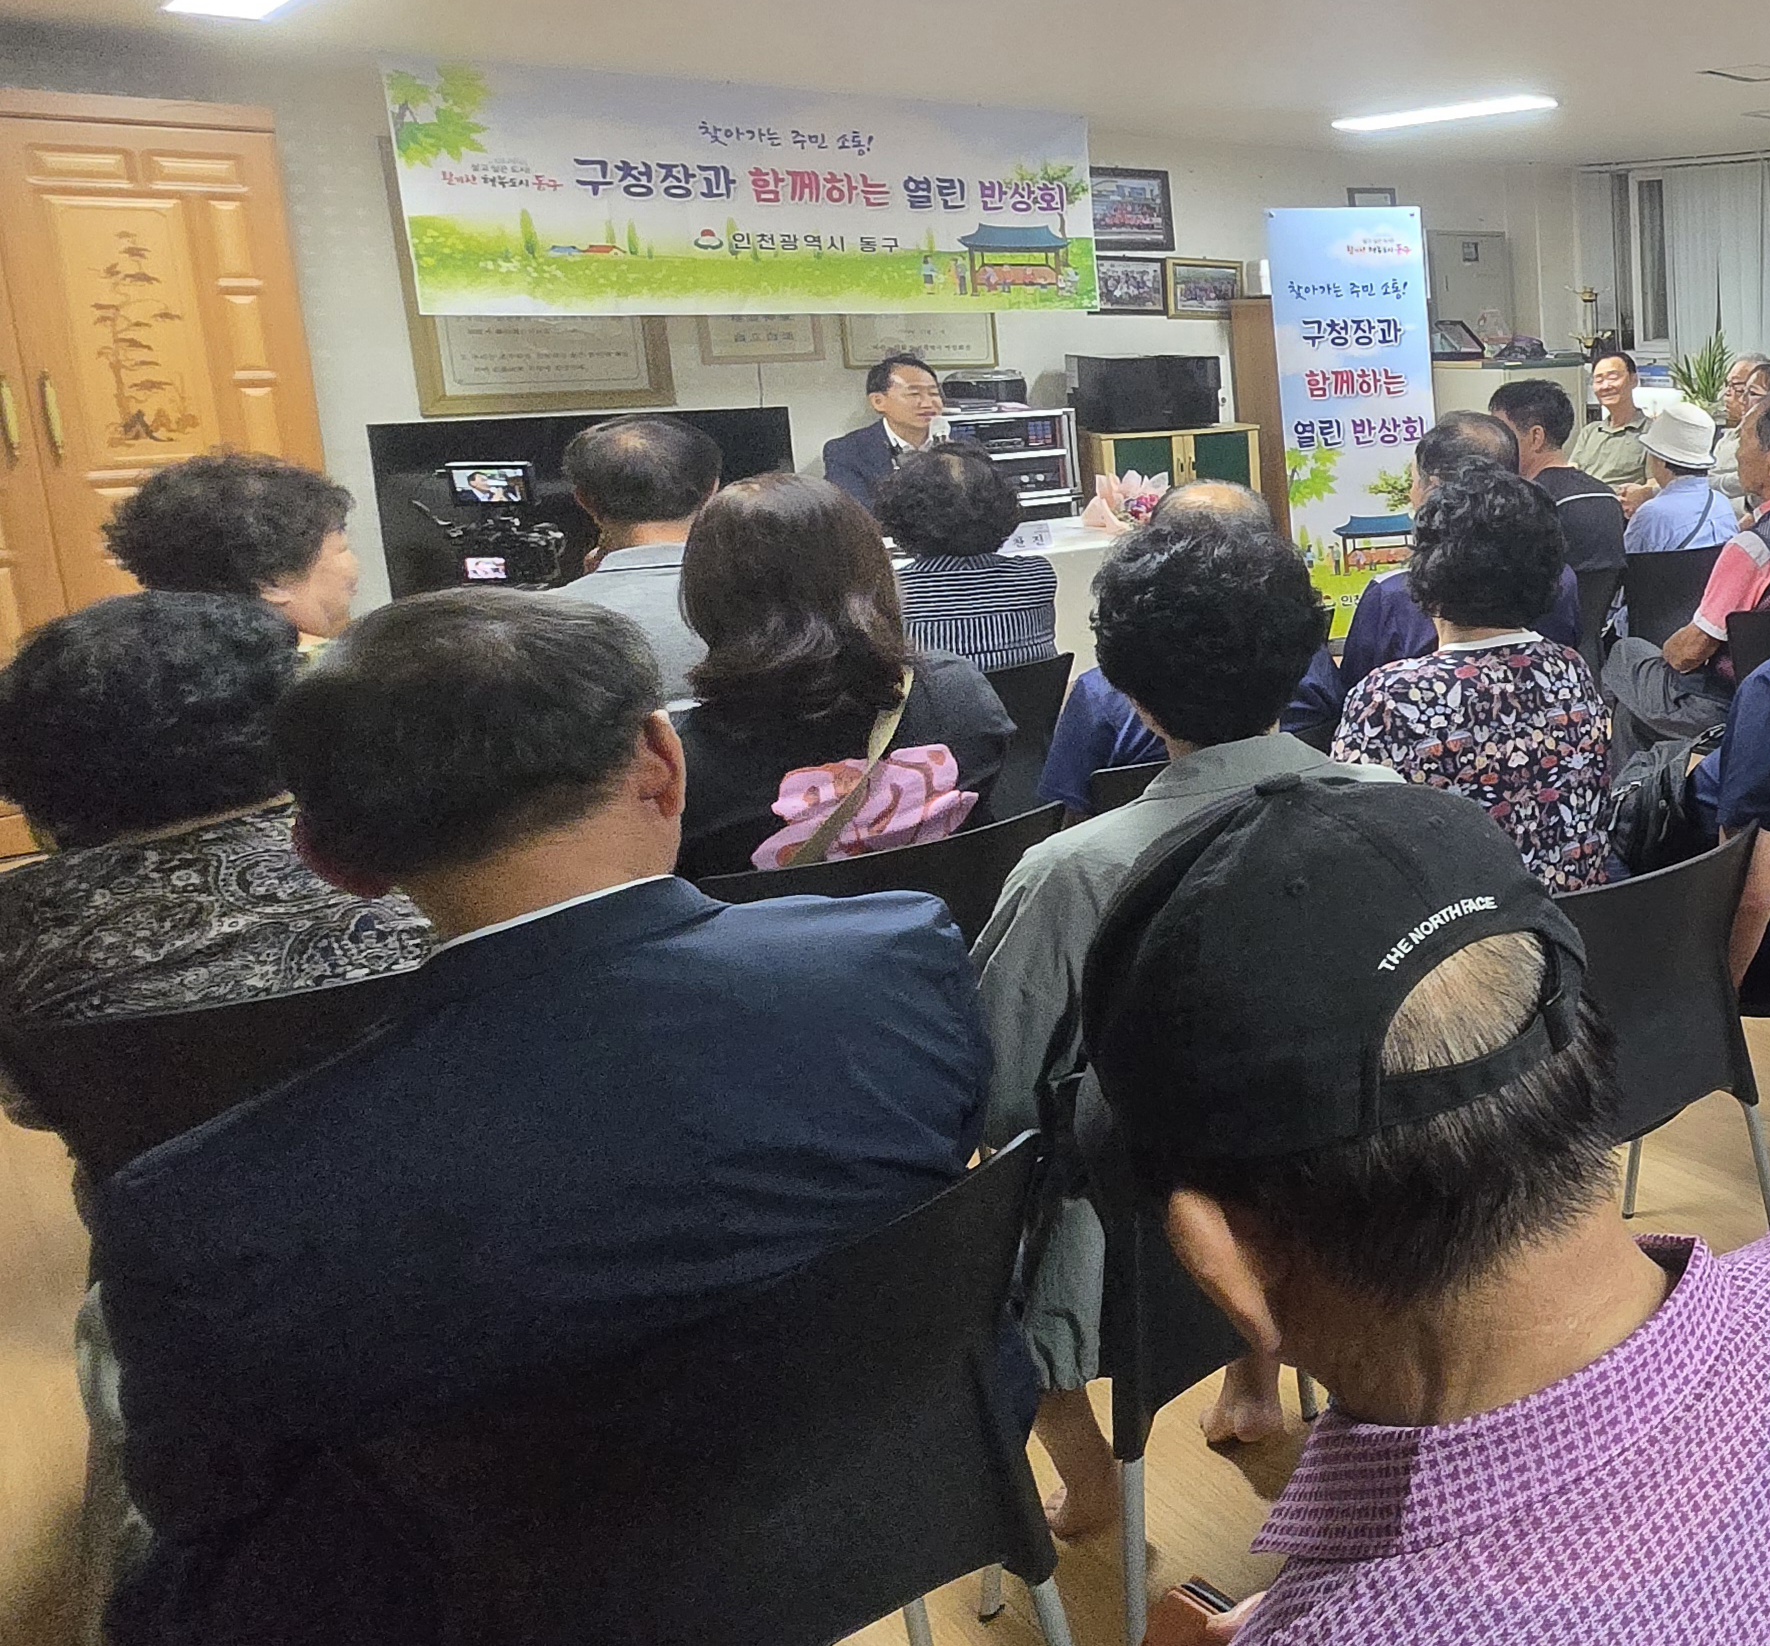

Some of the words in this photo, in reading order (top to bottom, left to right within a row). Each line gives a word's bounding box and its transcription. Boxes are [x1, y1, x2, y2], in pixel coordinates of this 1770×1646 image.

[699, 121, 782, 147] 찾아가는
[791, 129, 828, 150] 주민
[837, 131, 875, 157] 소통!
[532, 174, 564, 192] 동구
[573, 157, 737, 199] 구청장과
[748, 167, 891, 206] 함께하는
[903, 175, 966, 209] 열린
[978, 180, 1068, 213] 반상회
[732, 232, 845, 252] 인천광역시
[859, 236, 899, 253] 동구
[1288, 281, 1344, 301] 찾아가는
[1350, 282, 1376, 298] 주민
[1381, 278, 1408, 300] 소통!
[1302, 318, 1402, 348] 구청장과
[1305, 367, 1405, 398] 함께하는
[1293, 418, 1342, 449] 열린
[1351, 416, 1425, 446] 반상회
[1377, 937, 1413, 971] THE
[1408, 903, 1463, 945] NORTH
[1460, 896, 1498, 915] FACE
